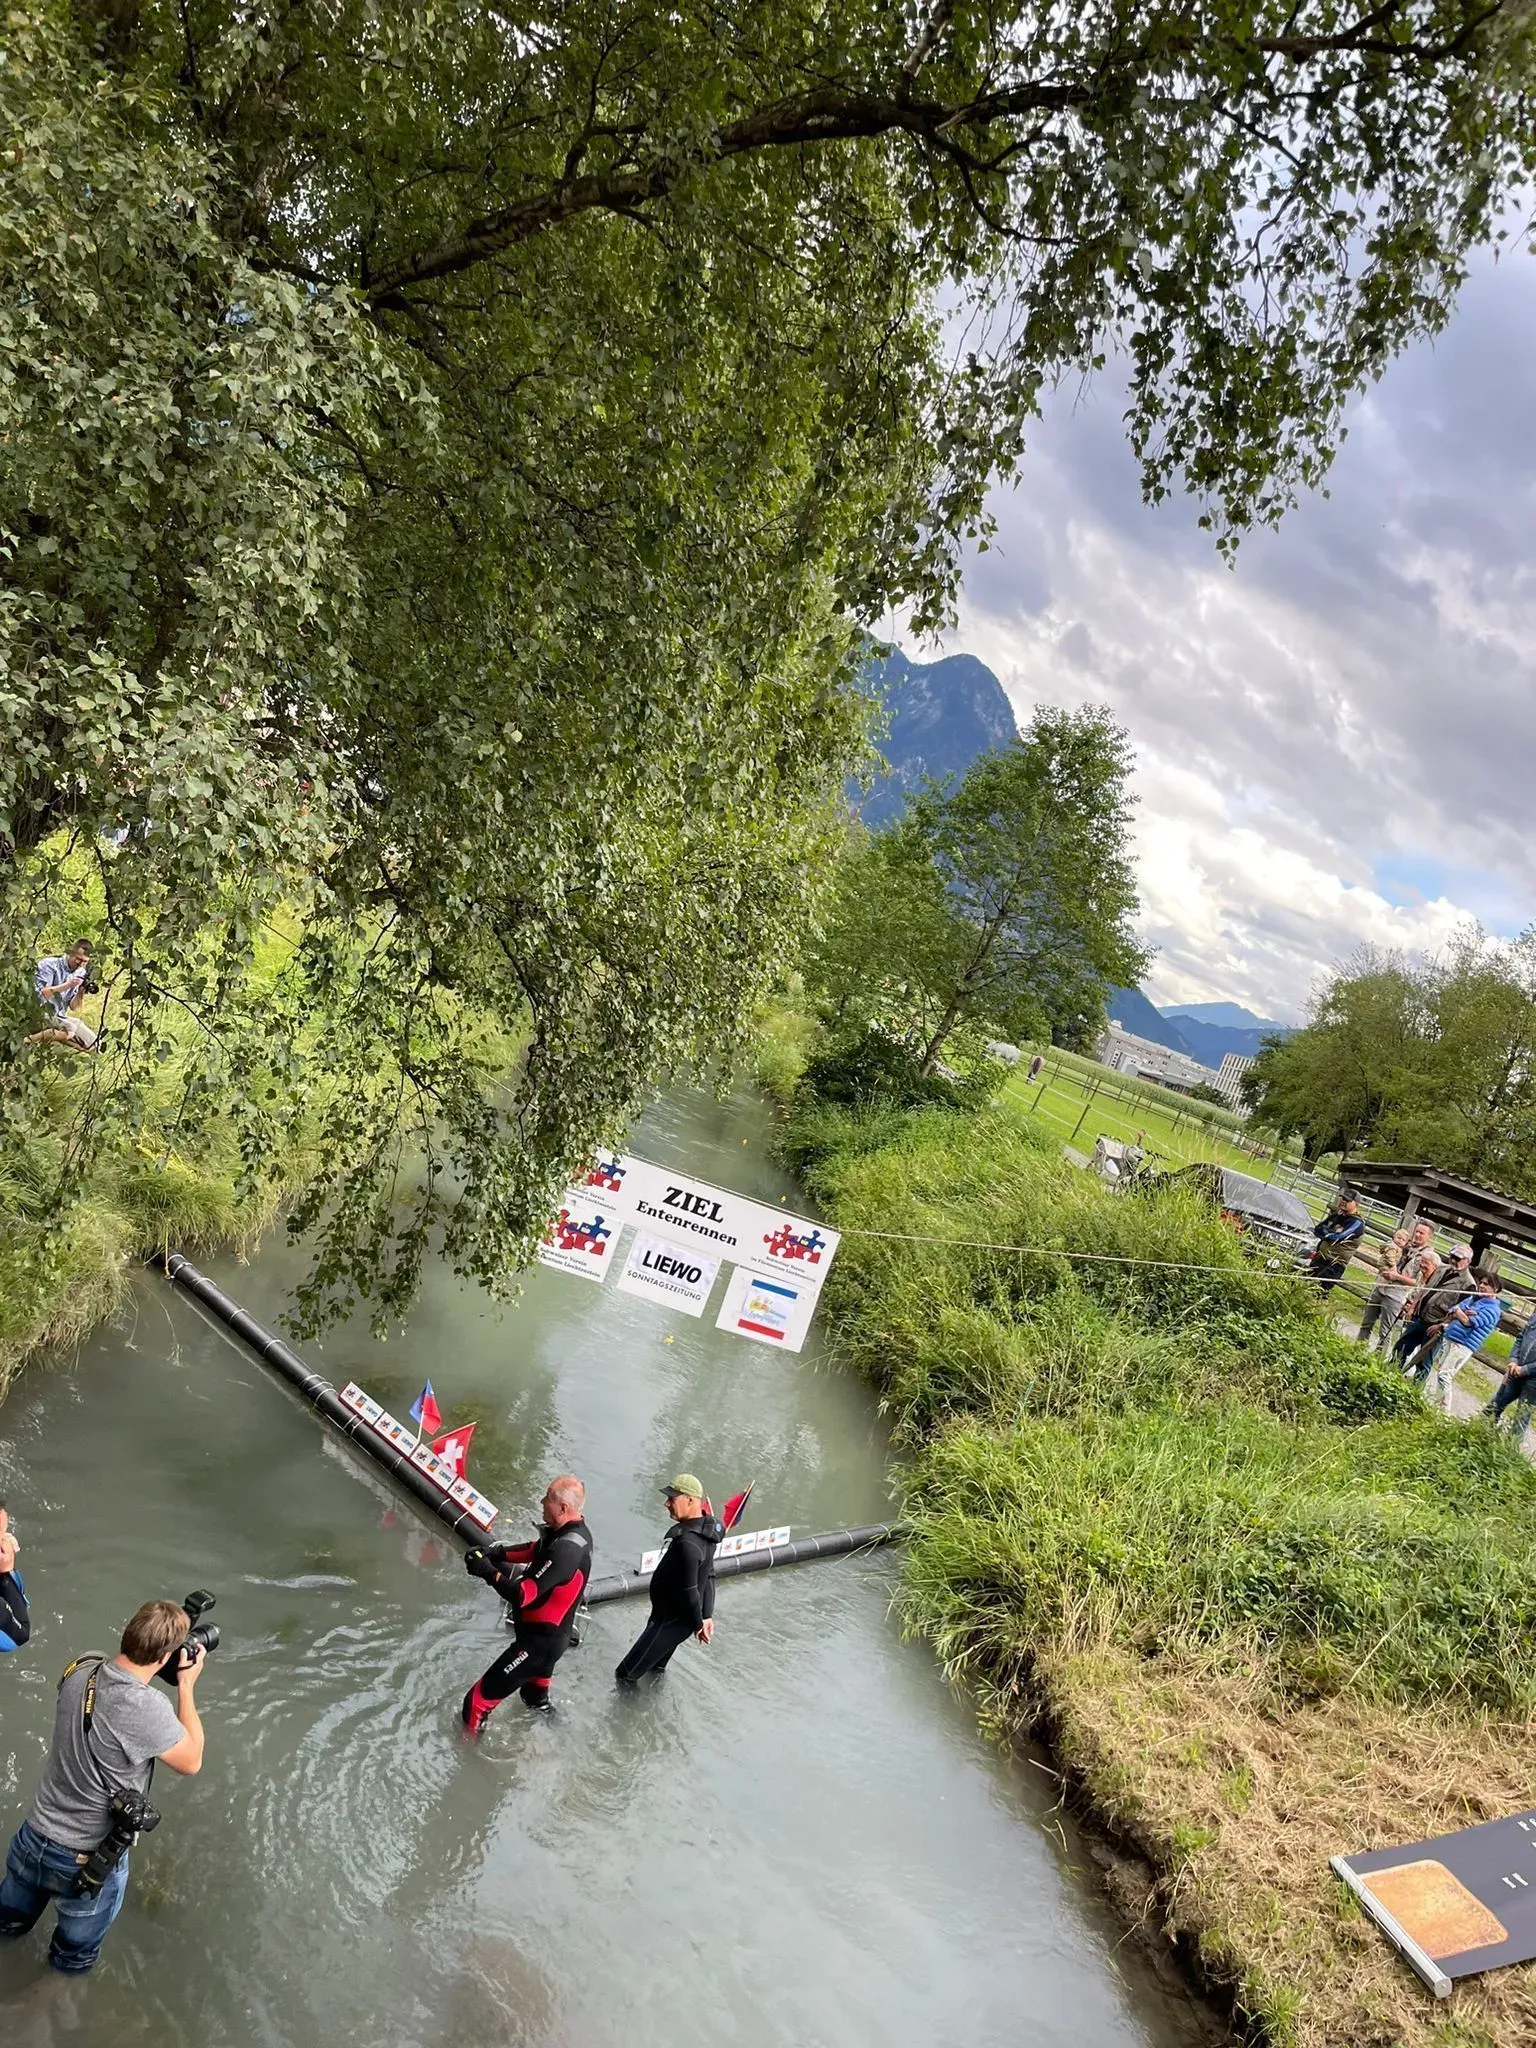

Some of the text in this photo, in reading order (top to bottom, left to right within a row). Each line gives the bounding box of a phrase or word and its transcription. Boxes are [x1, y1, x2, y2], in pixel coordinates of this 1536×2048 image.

[662, 1186, 724, 1223] ZIEL
[635, 1200, 738, 1246] Entenrennen
[642, 1250, 702, 1284] LIEWO
[627, 1270, 702, 1301] SONNTAGSZEITUNG
[535, 1559, 553, 1579] mares
[503, 1651, 529, 1675] mares
[85, 1689, 94, 1714] Nikon
